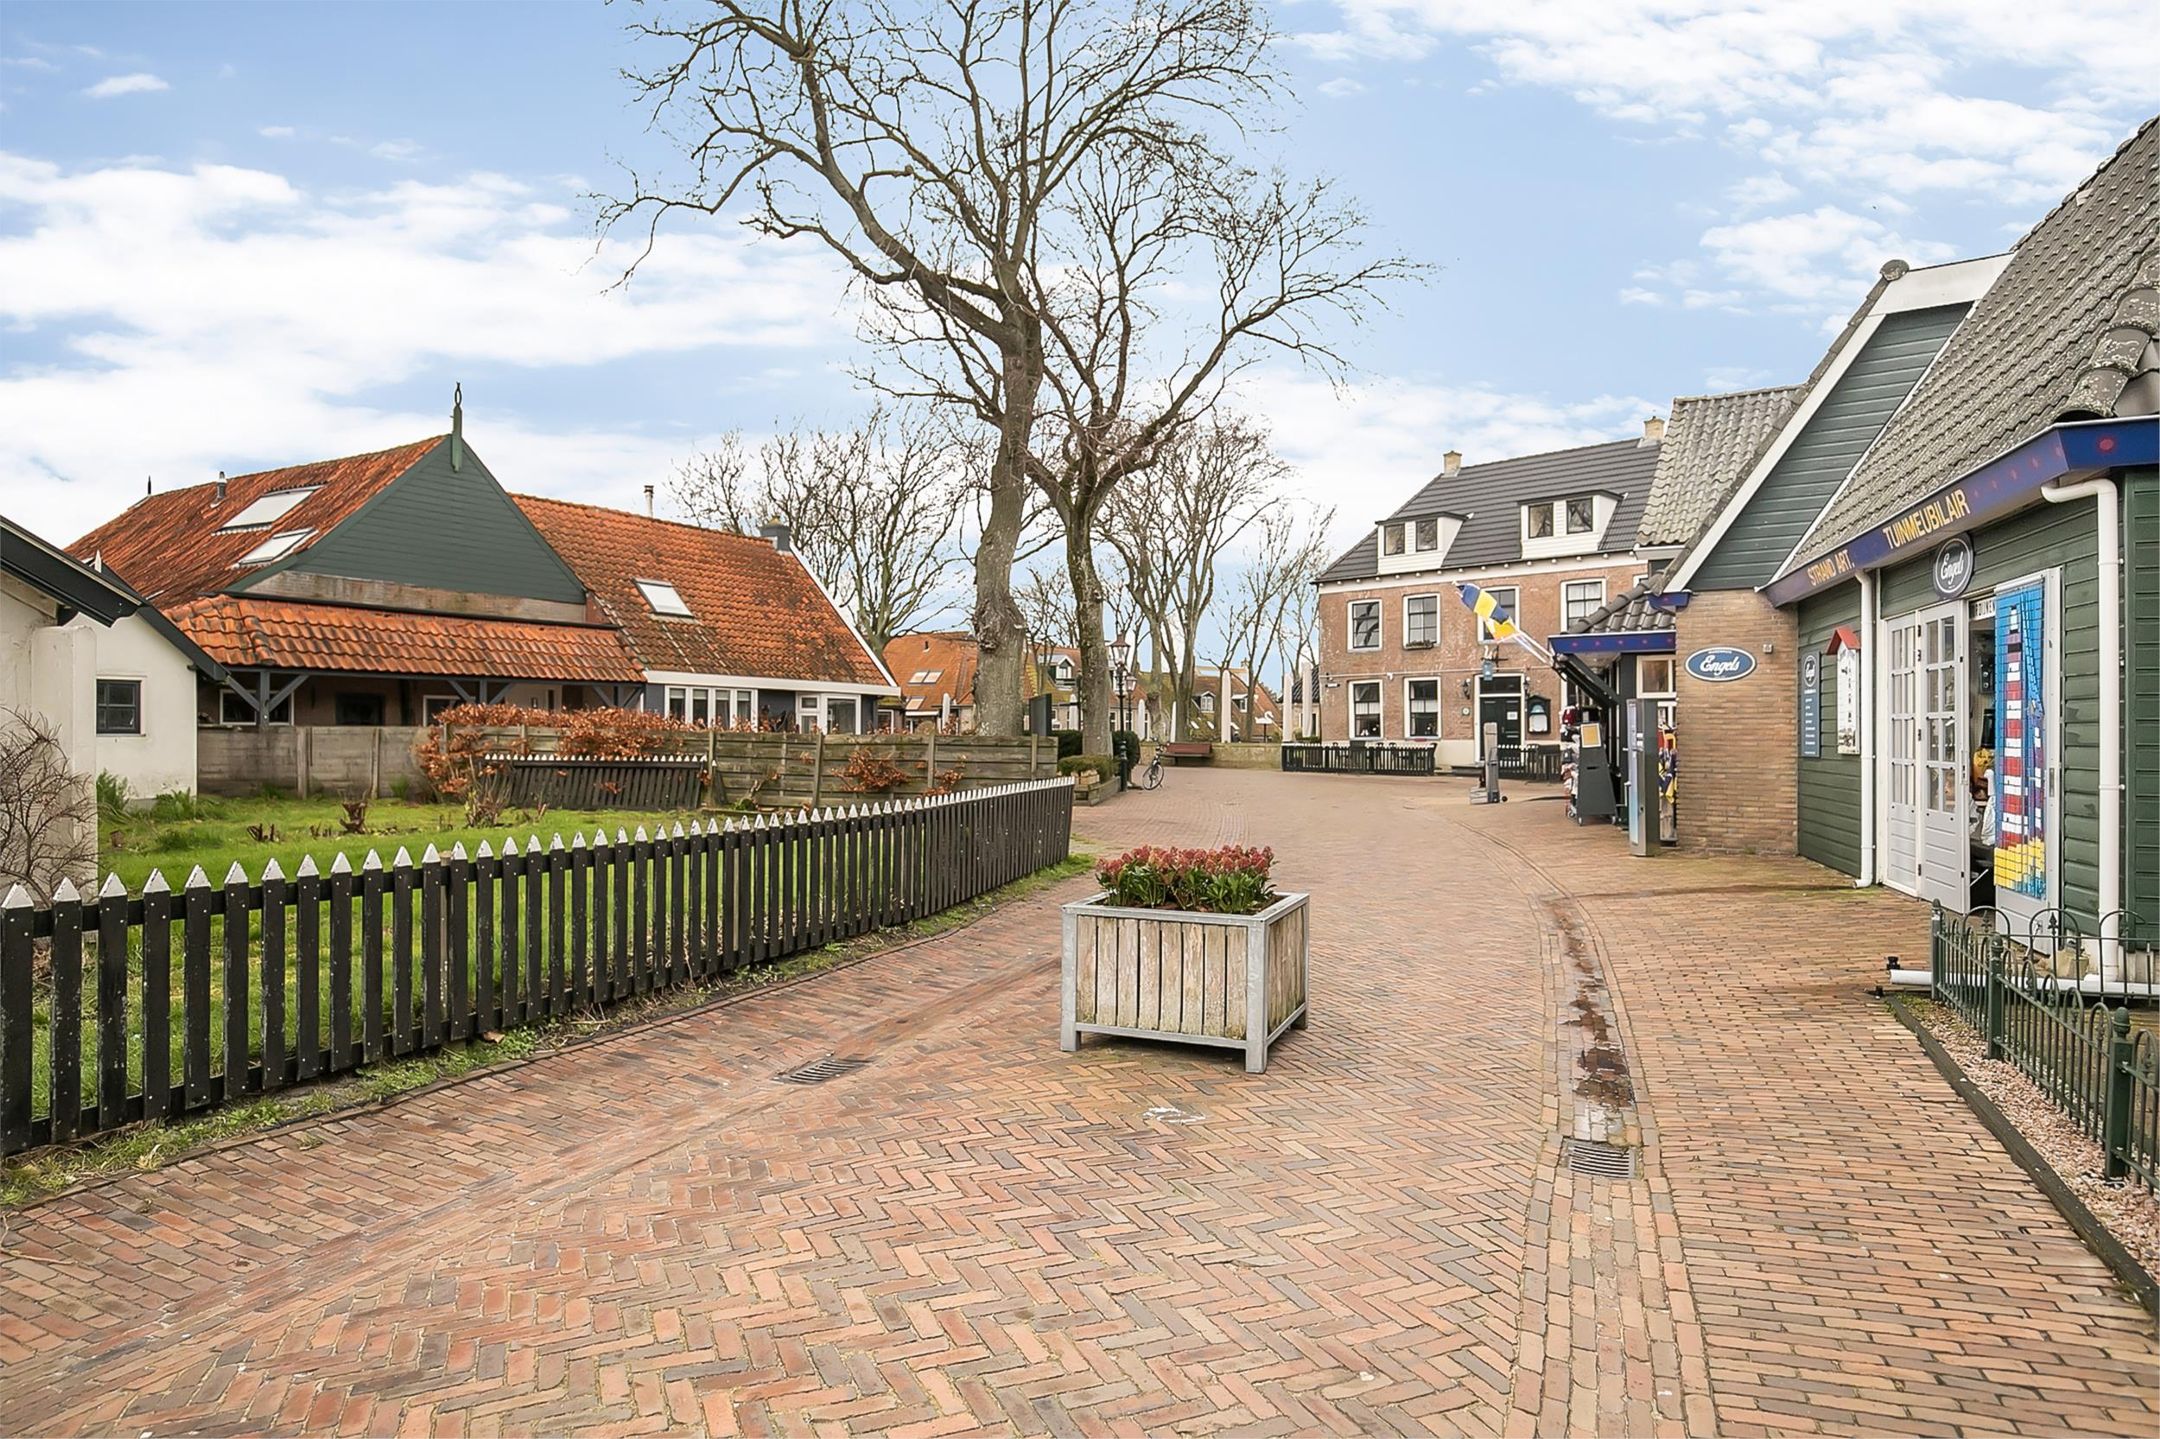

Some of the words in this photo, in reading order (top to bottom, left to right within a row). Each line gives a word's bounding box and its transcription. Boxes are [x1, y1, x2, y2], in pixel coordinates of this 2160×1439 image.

[1882, 489, 1971, 550] TUINMEUBILAIR
[1807, 558, 1837, 586] STRAND
[1940, 551, 1965, 586] Engels
[1699, 654, 1741, 677] Engels
